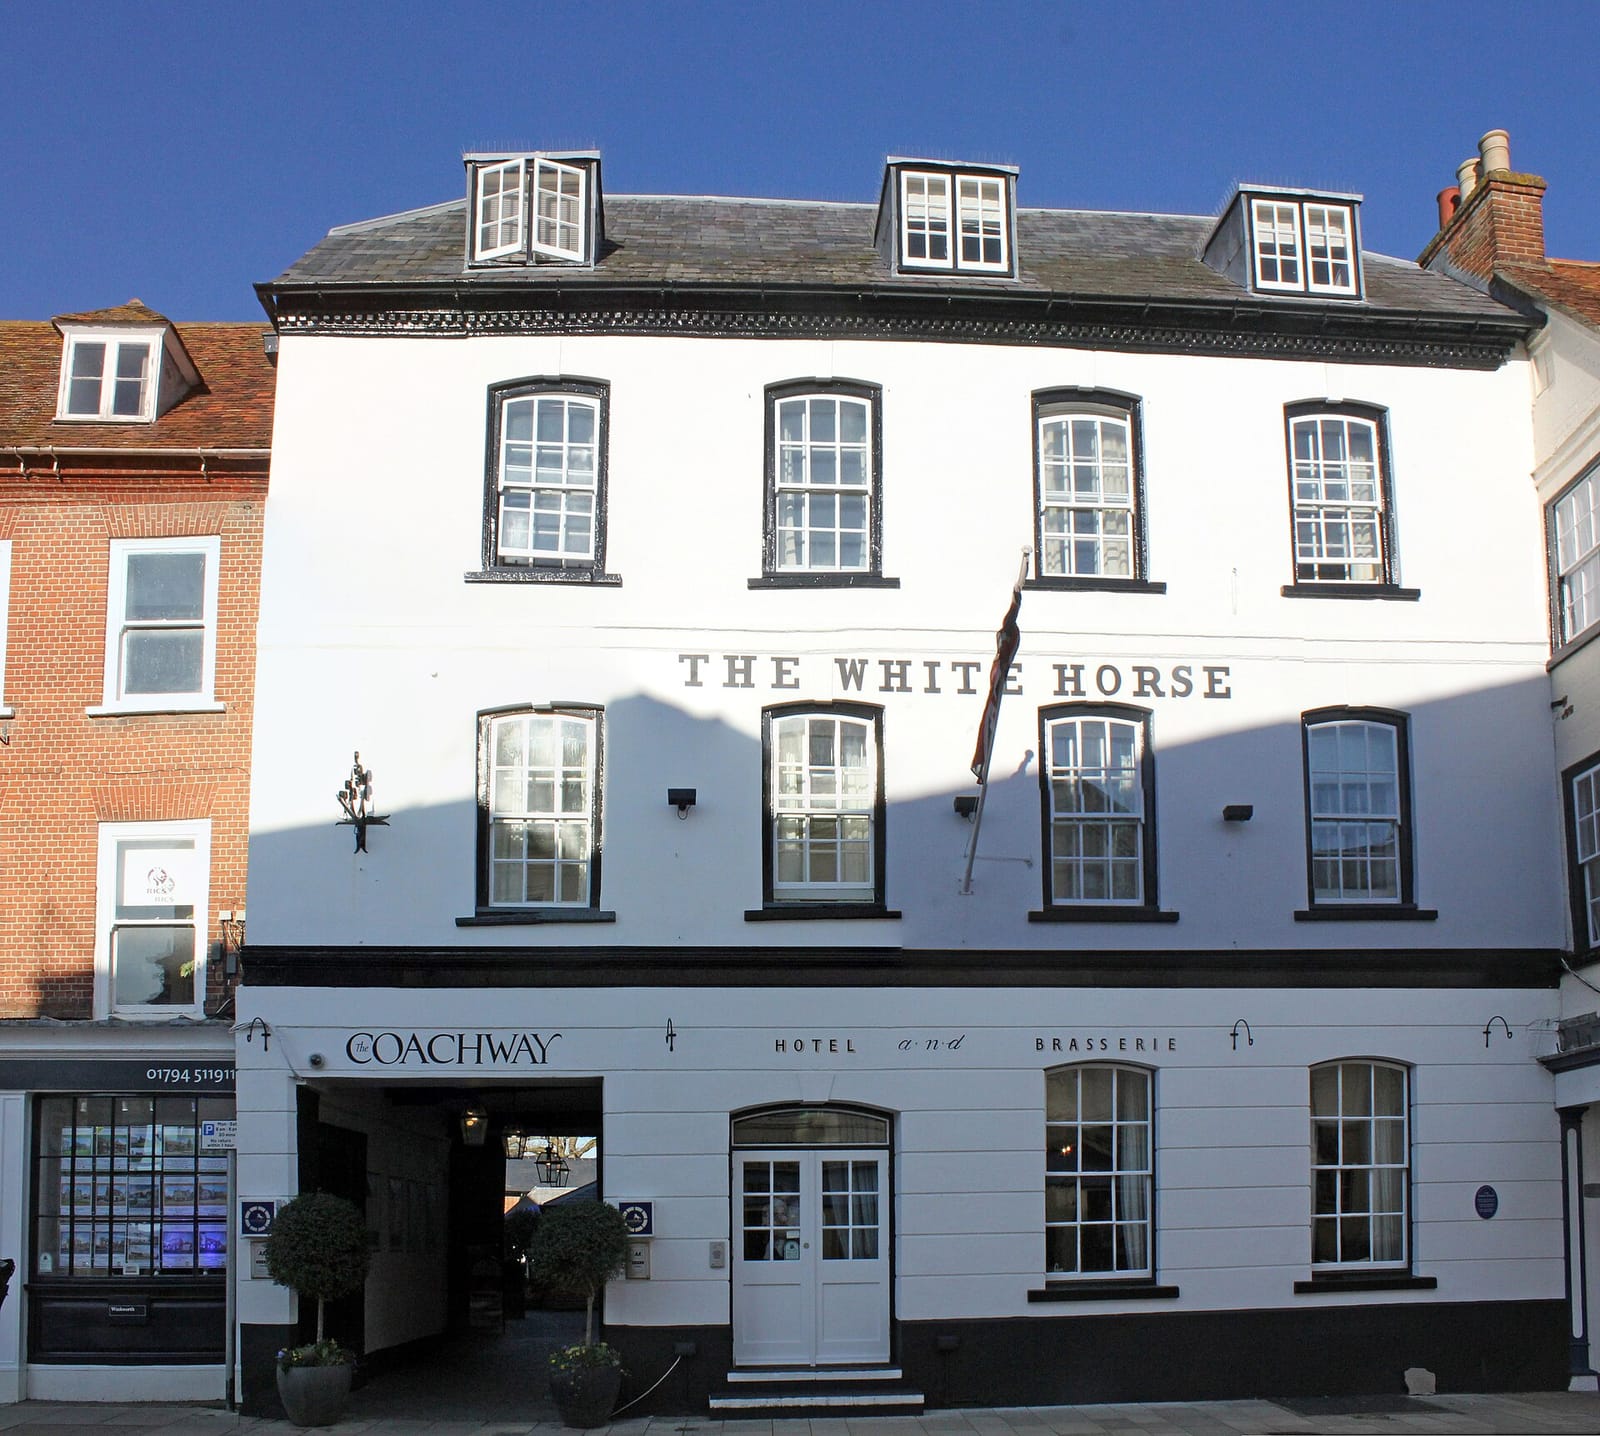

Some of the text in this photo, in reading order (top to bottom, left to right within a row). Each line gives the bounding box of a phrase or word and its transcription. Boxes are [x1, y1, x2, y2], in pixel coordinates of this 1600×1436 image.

[678, 653, 1232, 699] THE WHITE HORSE
[345, 1032, 563, 1065] COACHWAY
[354, 1040, 369, 1053] The
[775, 1039, 856, 1053] HOTEL
[1036, 1038, 1177, 1052] BRASSERIE
[146, 1068, 235, 1083] 01794 511911
